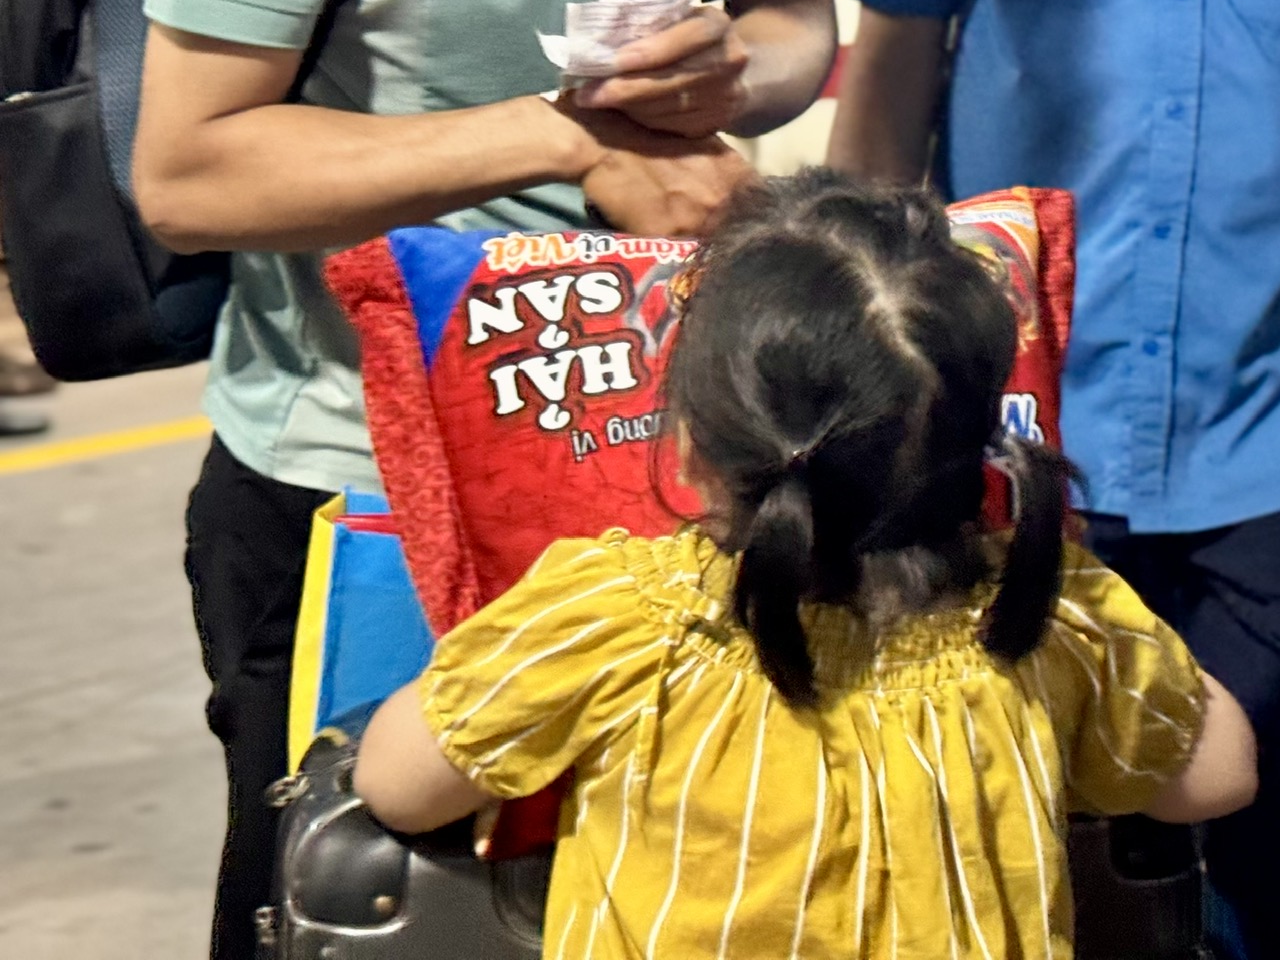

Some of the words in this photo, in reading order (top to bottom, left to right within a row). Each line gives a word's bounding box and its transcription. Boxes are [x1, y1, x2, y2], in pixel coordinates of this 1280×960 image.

[575, 233, 616, 263] vị
[467, 271, 623, 349] SẢN
[489, 341, 638, 430] HẢI
[571, 429, 599, 462] vị
